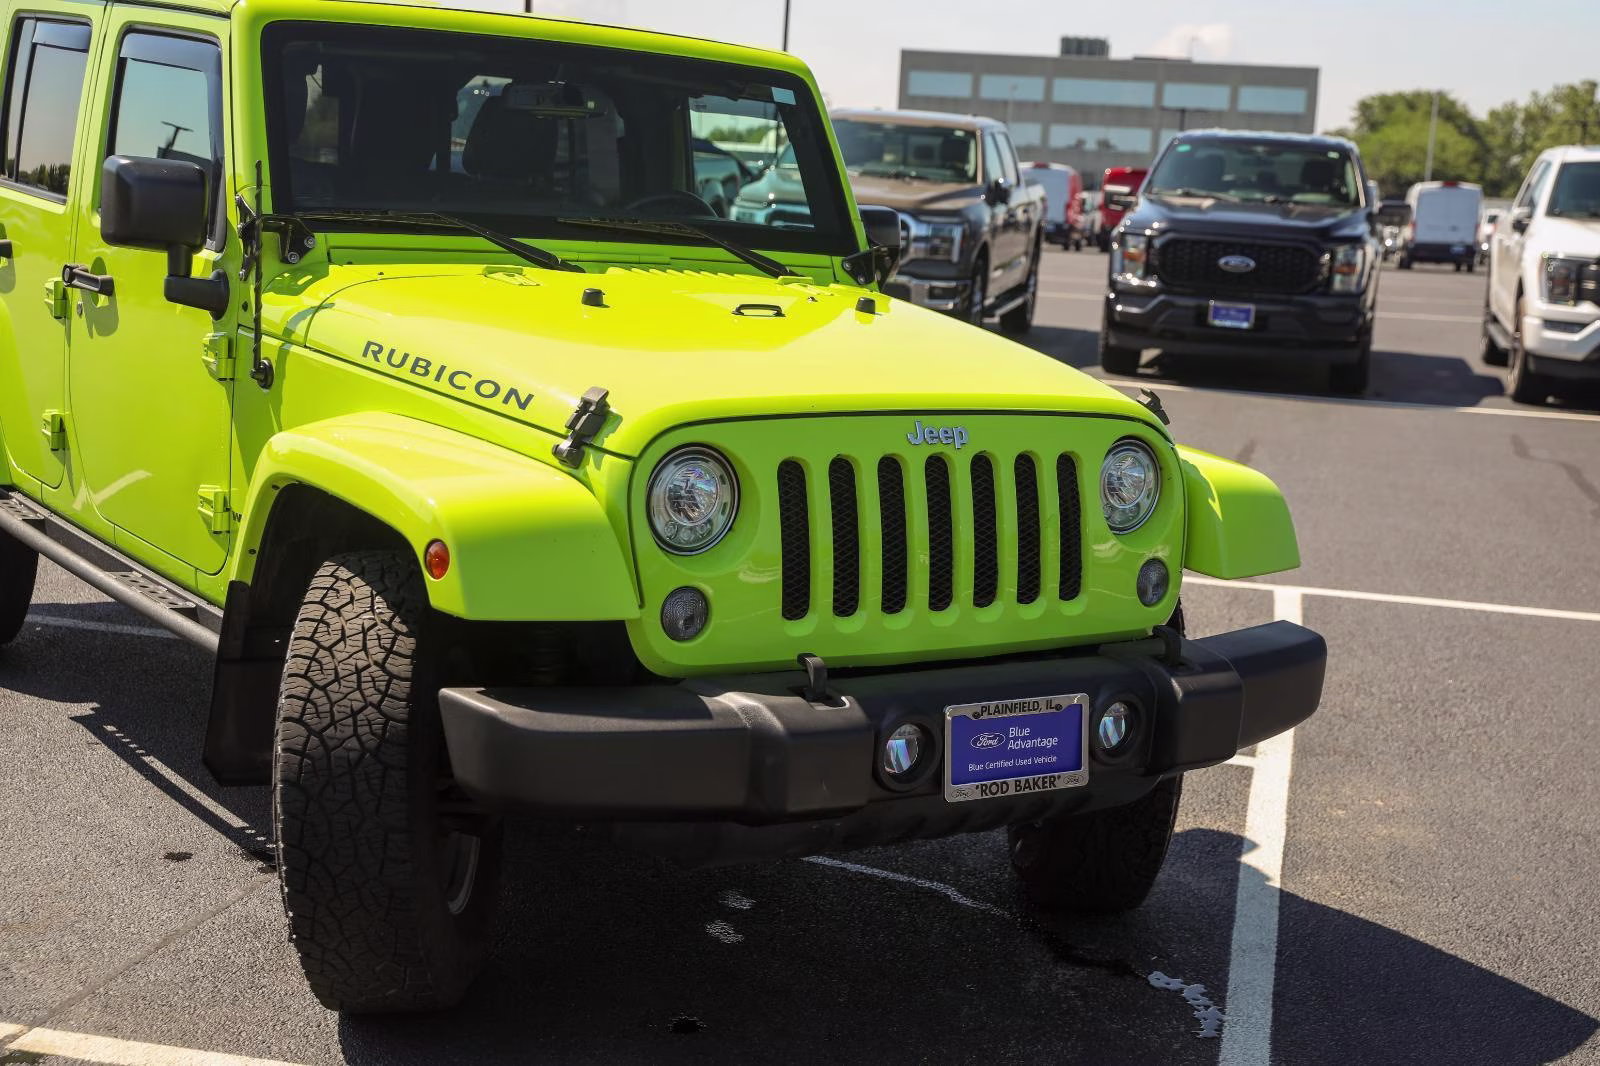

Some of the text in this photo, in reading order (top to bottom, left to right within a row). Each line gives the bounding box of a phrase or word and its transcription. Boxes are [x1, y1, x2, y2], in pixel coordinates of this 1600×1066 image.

[362, 340, 535, 411] RUBICON
[906, 420, 968, 449] Jeep
[980, 699, 1055, 717] PLAINFIELD, IL
[976, 734, 999, 747] Ford
[1009, 726, 1030, 738] Blue
[1007, 737, 1058, 750] Advantage
[968, 755, 1057, 772] Blue Certified Used Vehicle
